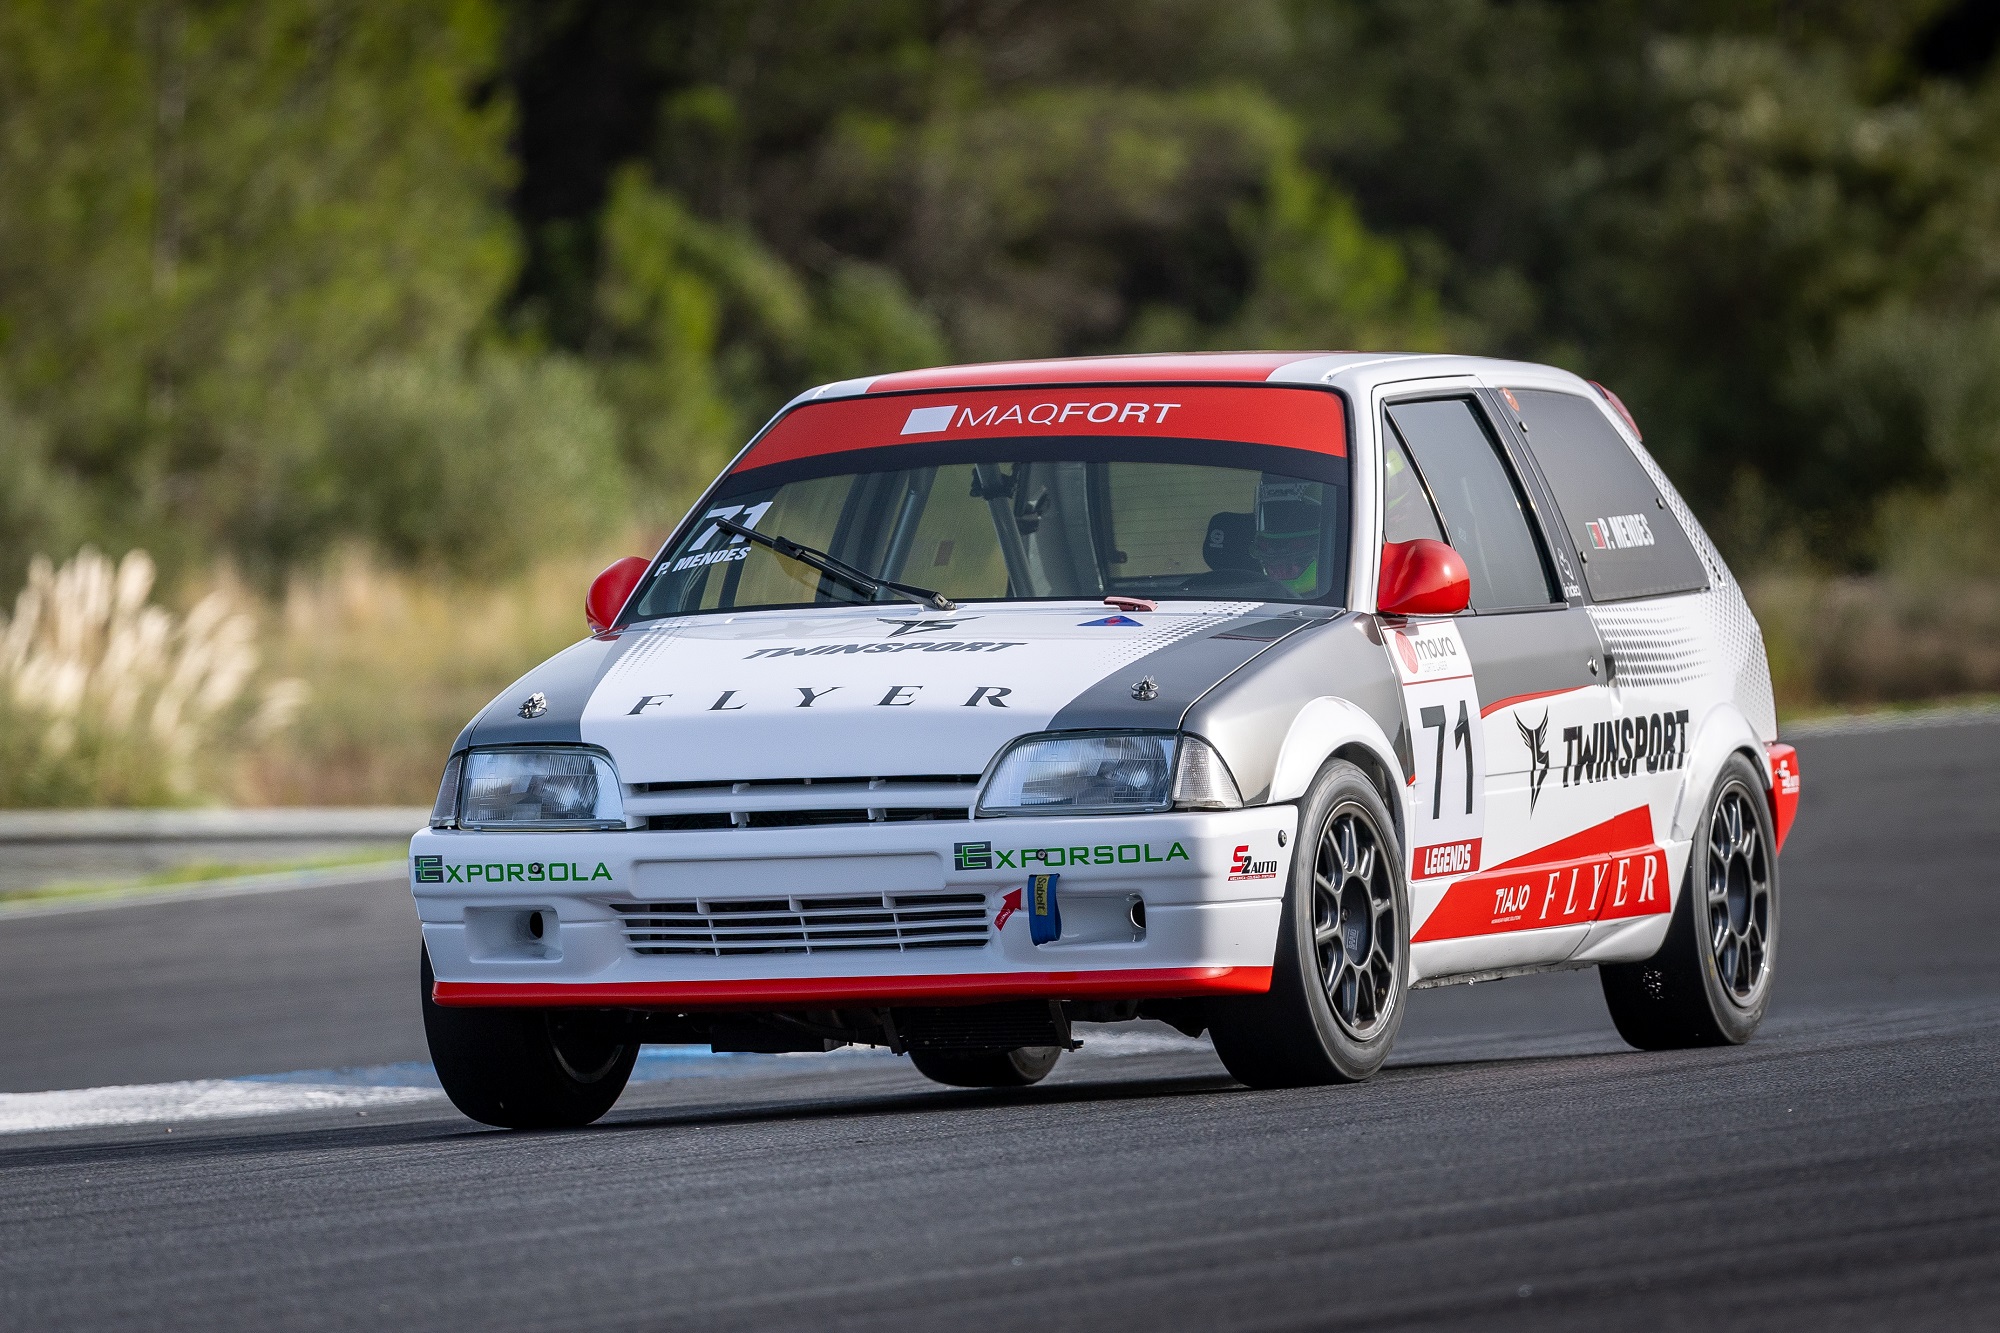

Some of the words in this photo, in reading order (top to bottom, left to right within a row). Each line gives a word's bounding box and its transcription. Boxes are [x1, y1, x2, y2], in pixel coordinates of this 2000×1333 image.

[956, 402, 1182, 428] MAQFORT
[688, 501, 774, 552] 71
[1607, 513, 1655, 549] MENDES
[653, 561, 671, 577] P.
[671, 546, 752, 573] MENDES
[742, 641, 1029, 660] TWINSPORT
[1414, 636, 1457, 660] moura
[623, 685, 1013, 716] FLYER
[1420, 700, 1474, 820] 71
[1562, 709, 1689, 788] TWINSPORT
[1424, 843, 1472, 876] LEGENDS
[1036, 876, 1047, 911] Sabelt
[1538, 854, 1658, 920] FLYER
